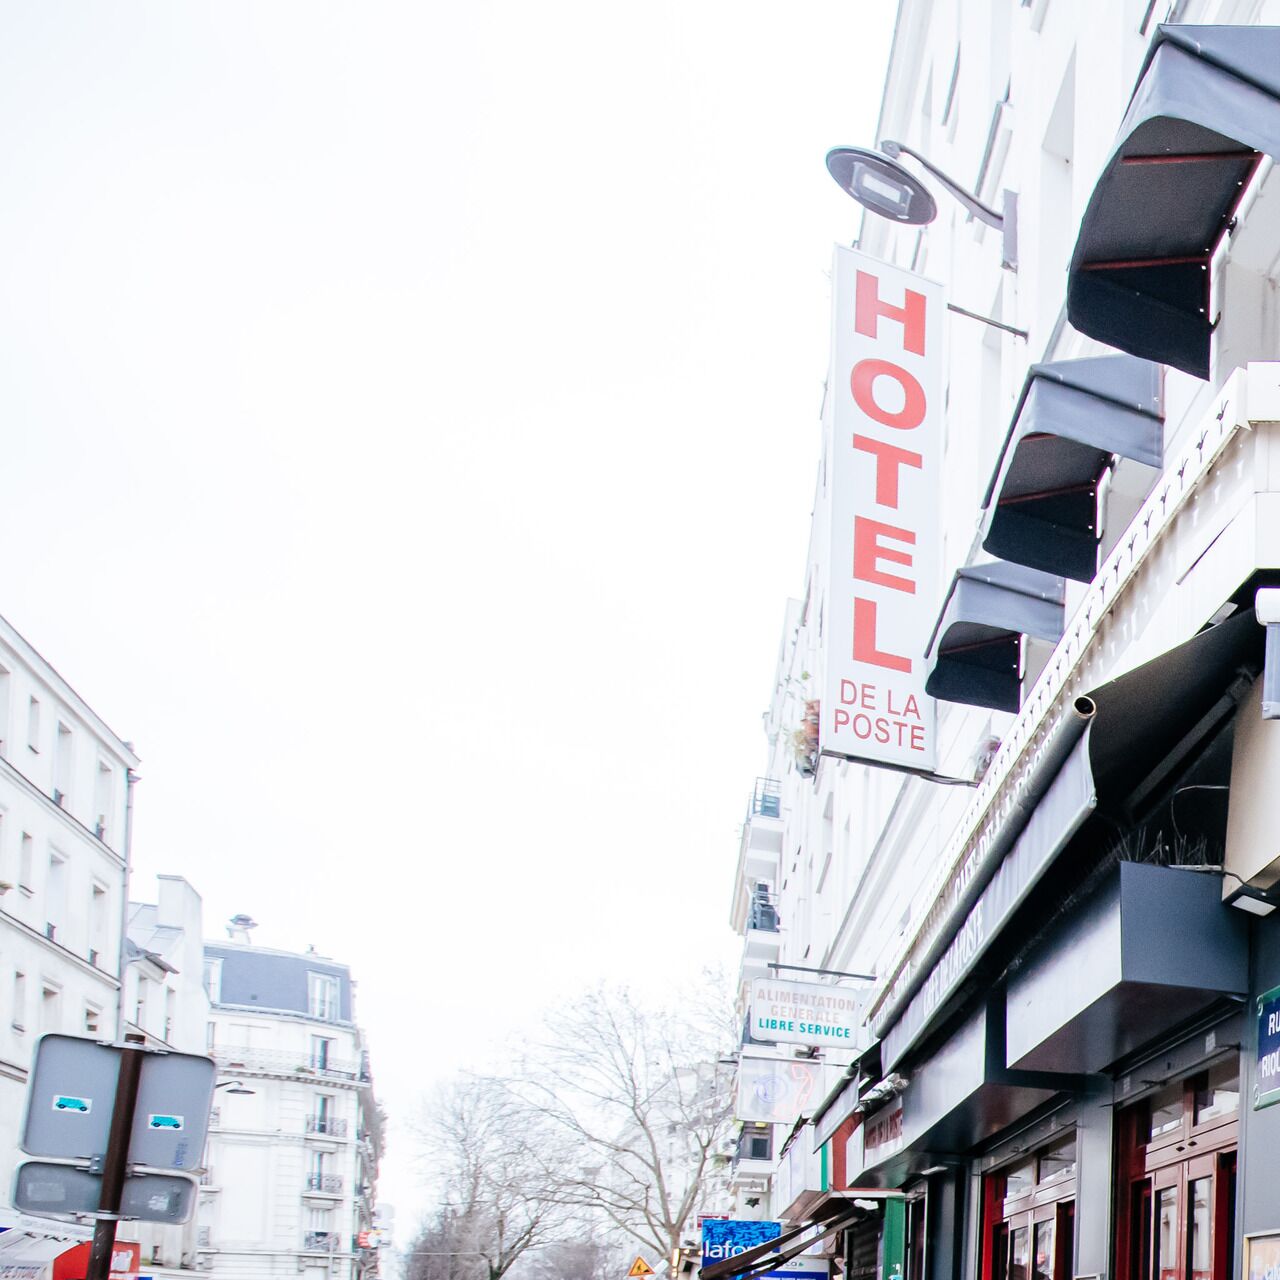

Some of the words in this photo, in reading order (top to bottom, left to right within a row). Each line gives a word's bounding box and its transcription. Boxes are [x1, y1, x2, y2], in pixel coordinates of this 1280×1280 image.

[850, 269, 927, 673] HOTEL
[839, 679, 877, 711] DE
[886, 686, 921, 720] LA
[834, 709, 925, 751] POSTE
[757, 988, 856, 1011] ALIMENTATION
[770, 1005, 840, 1024] GENERALE
[759, 1018, 794, 1032] LIBRE
[799, 1022, 851, 1038] SERVICE
